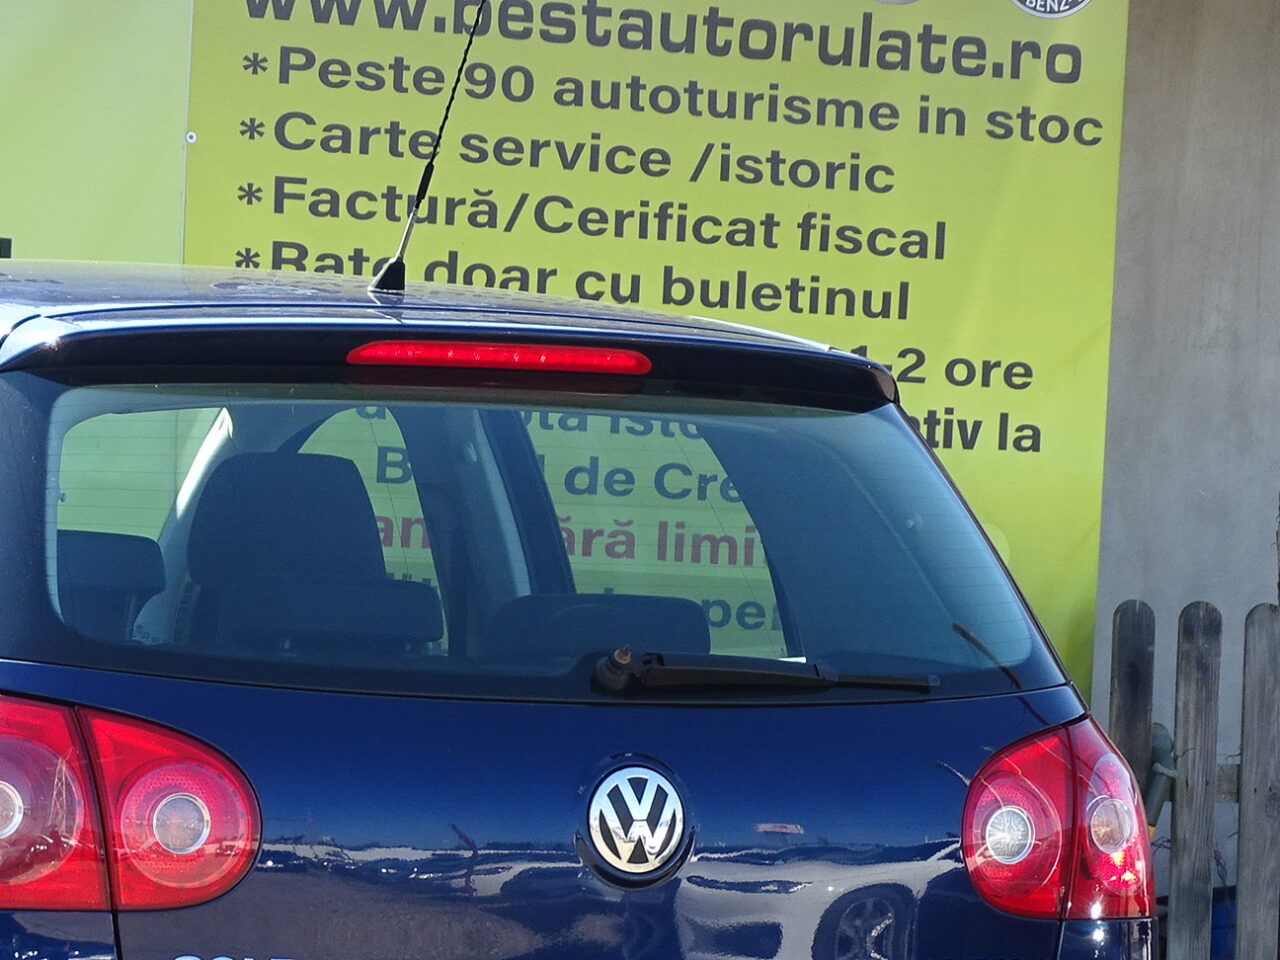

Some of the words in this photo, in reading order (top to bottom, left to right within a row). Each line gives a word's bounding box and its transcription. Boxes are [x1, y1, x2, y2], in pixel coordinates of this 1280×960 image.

[463, 62, 535, 103] 90
[553, 75, 901, 131] autoturisme
[918, 94, 967, 137] in
[985, 106, 1104, 147] stoc
[459, 132, 671, 177] service
[797, 211, 946, 260] fiscal
[424, 251, 558, 294] doar
[575, 270, 641, 304] cu
[662, 265, 910, 320] buletinul
[945, 358, 1034, 390] ore
[999, 412, 1041, 452] la
[564, 456, 635, 497] de
[657, 521, 768, 566] limi
